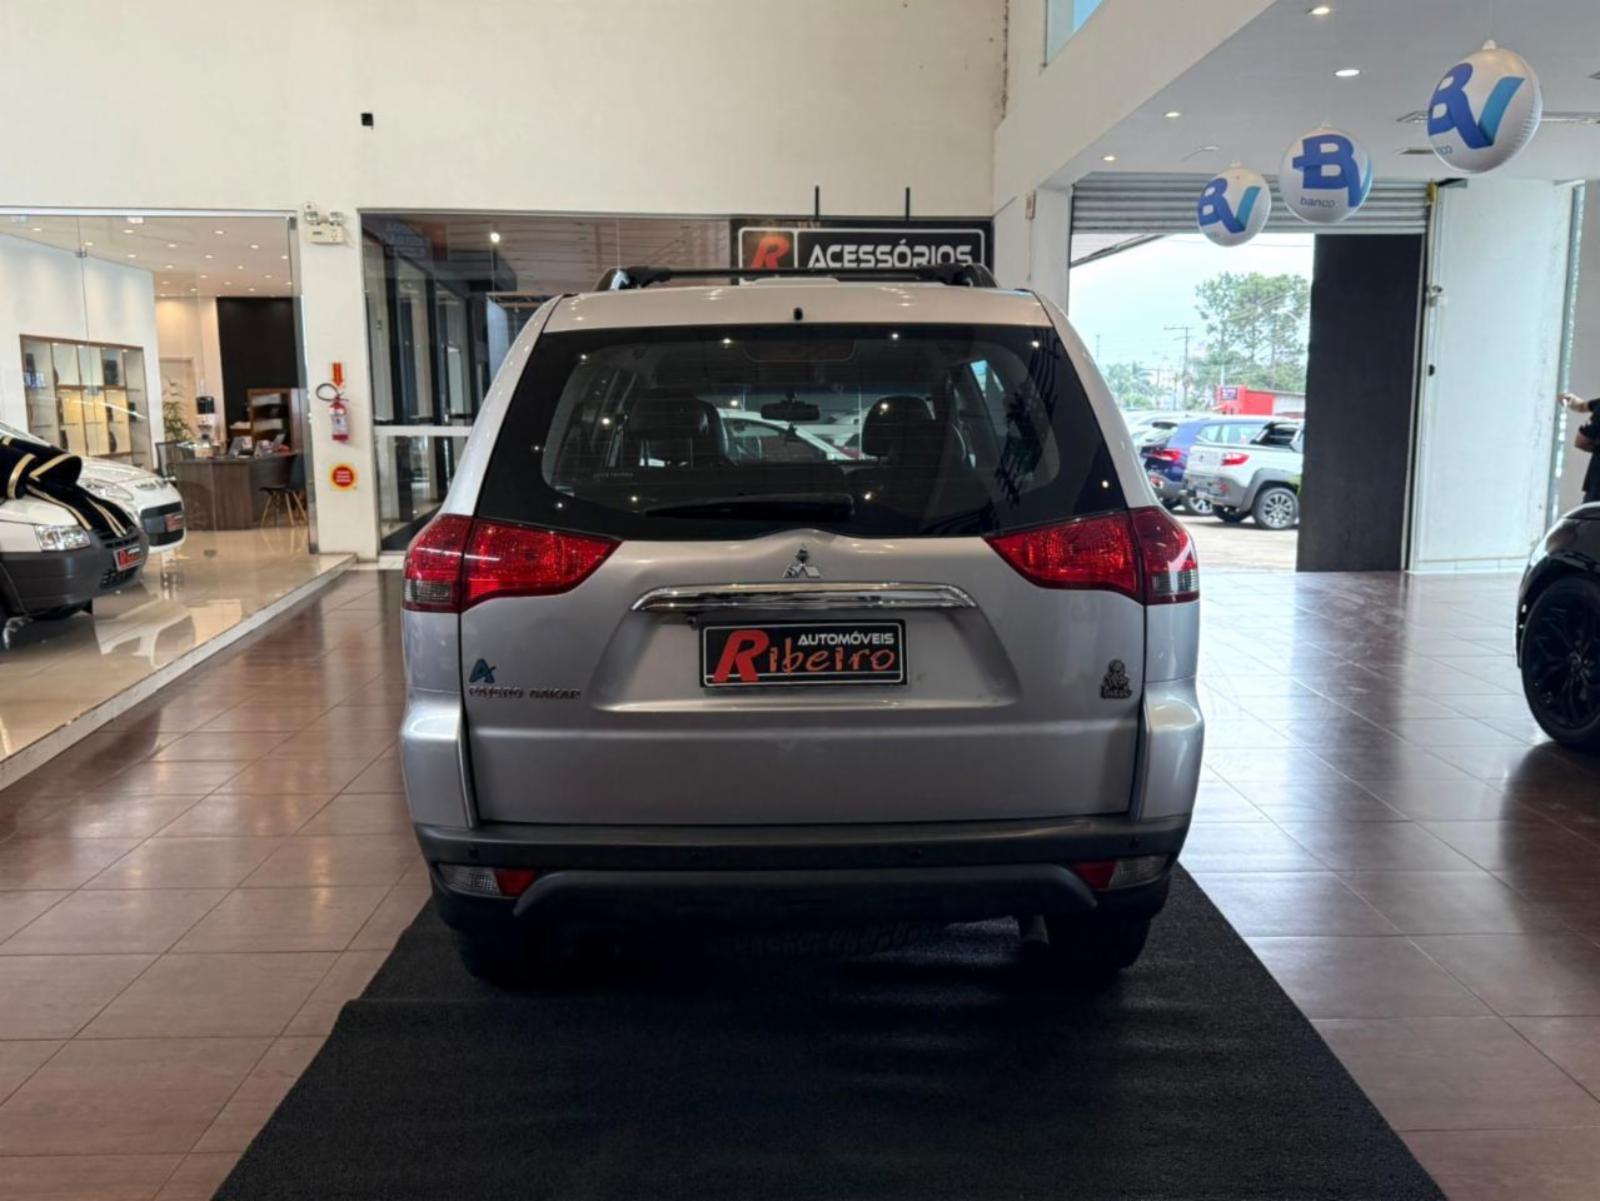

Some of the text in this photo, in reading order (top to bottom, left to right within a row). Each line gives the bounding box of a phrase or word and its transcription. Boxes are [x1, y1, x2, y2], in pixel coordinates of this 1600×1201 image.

[1300, 196, 1336, 209] banco
[751, 235, 973, 271] R ACESSÓRIOS
[797, 631, 895, 646] AUTOMÓVEIS
[712, 629, 896, 684] Ribeiro
